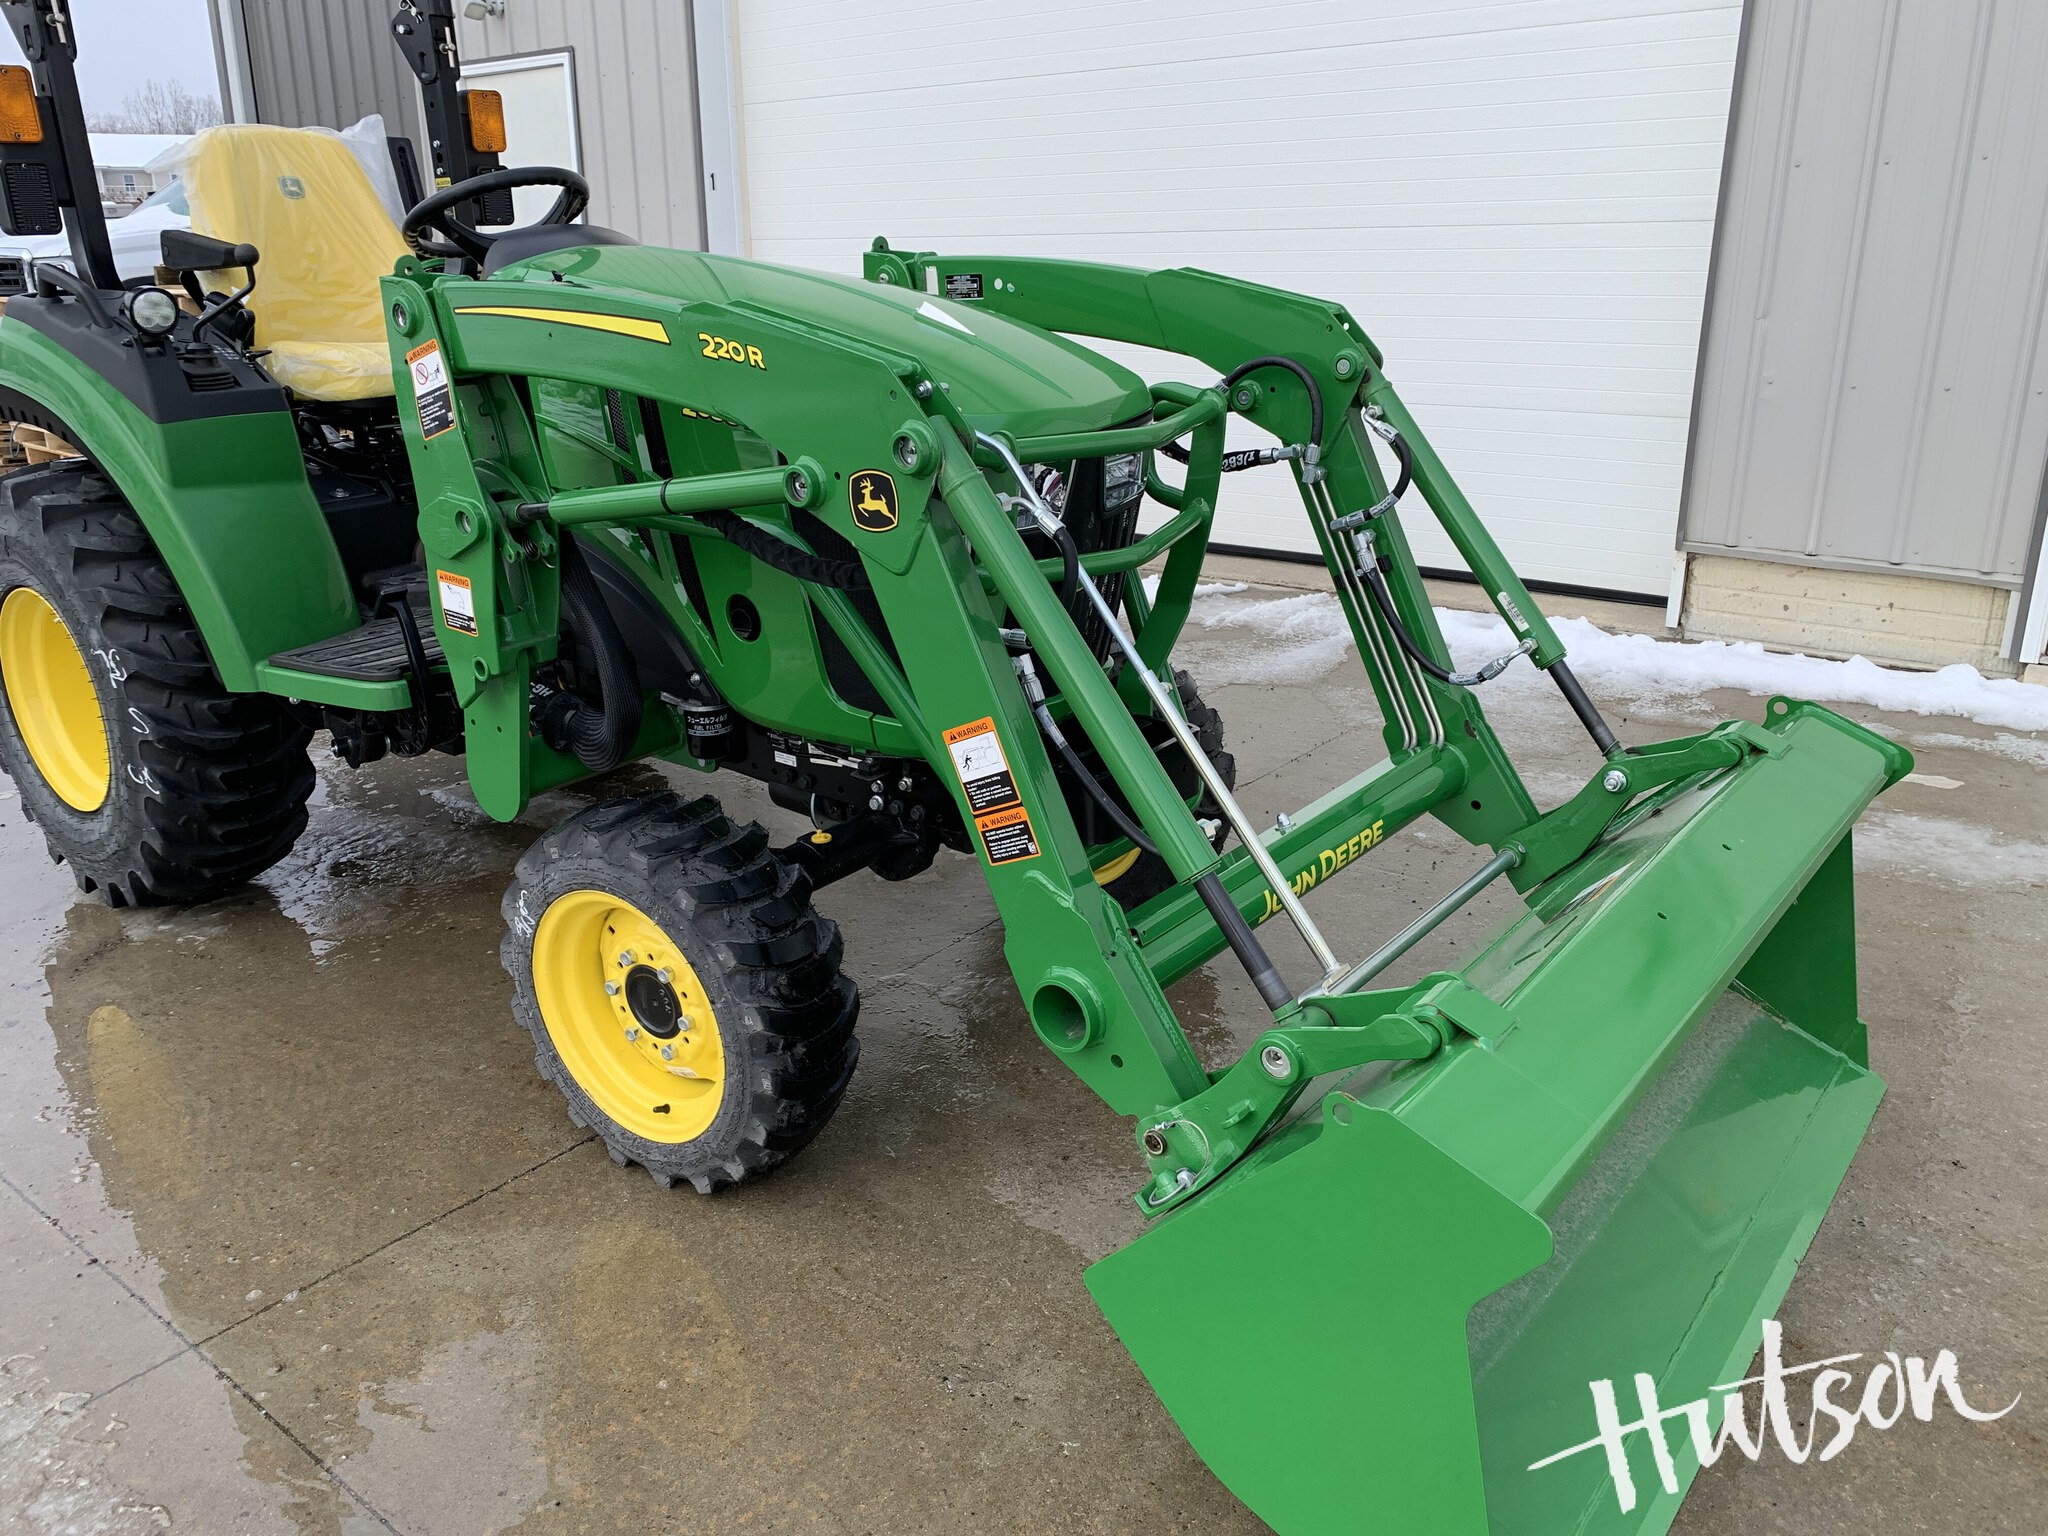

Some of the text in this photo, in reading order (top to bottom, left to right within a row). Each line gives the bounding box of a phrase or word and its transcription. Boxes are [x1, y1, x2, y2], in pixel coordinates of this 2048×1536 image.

[412, 341, 437, 359] WARNING
[697, 332, 767, 371] 220R
[444, 575, 469, 587] WARNING
[706, 723, 723, 731] FILTER
[956, 722, 989, 738] WARNING
[989, 812, 1022, 826] WARNING
[1319, 819, 1384, 881] DEERE
